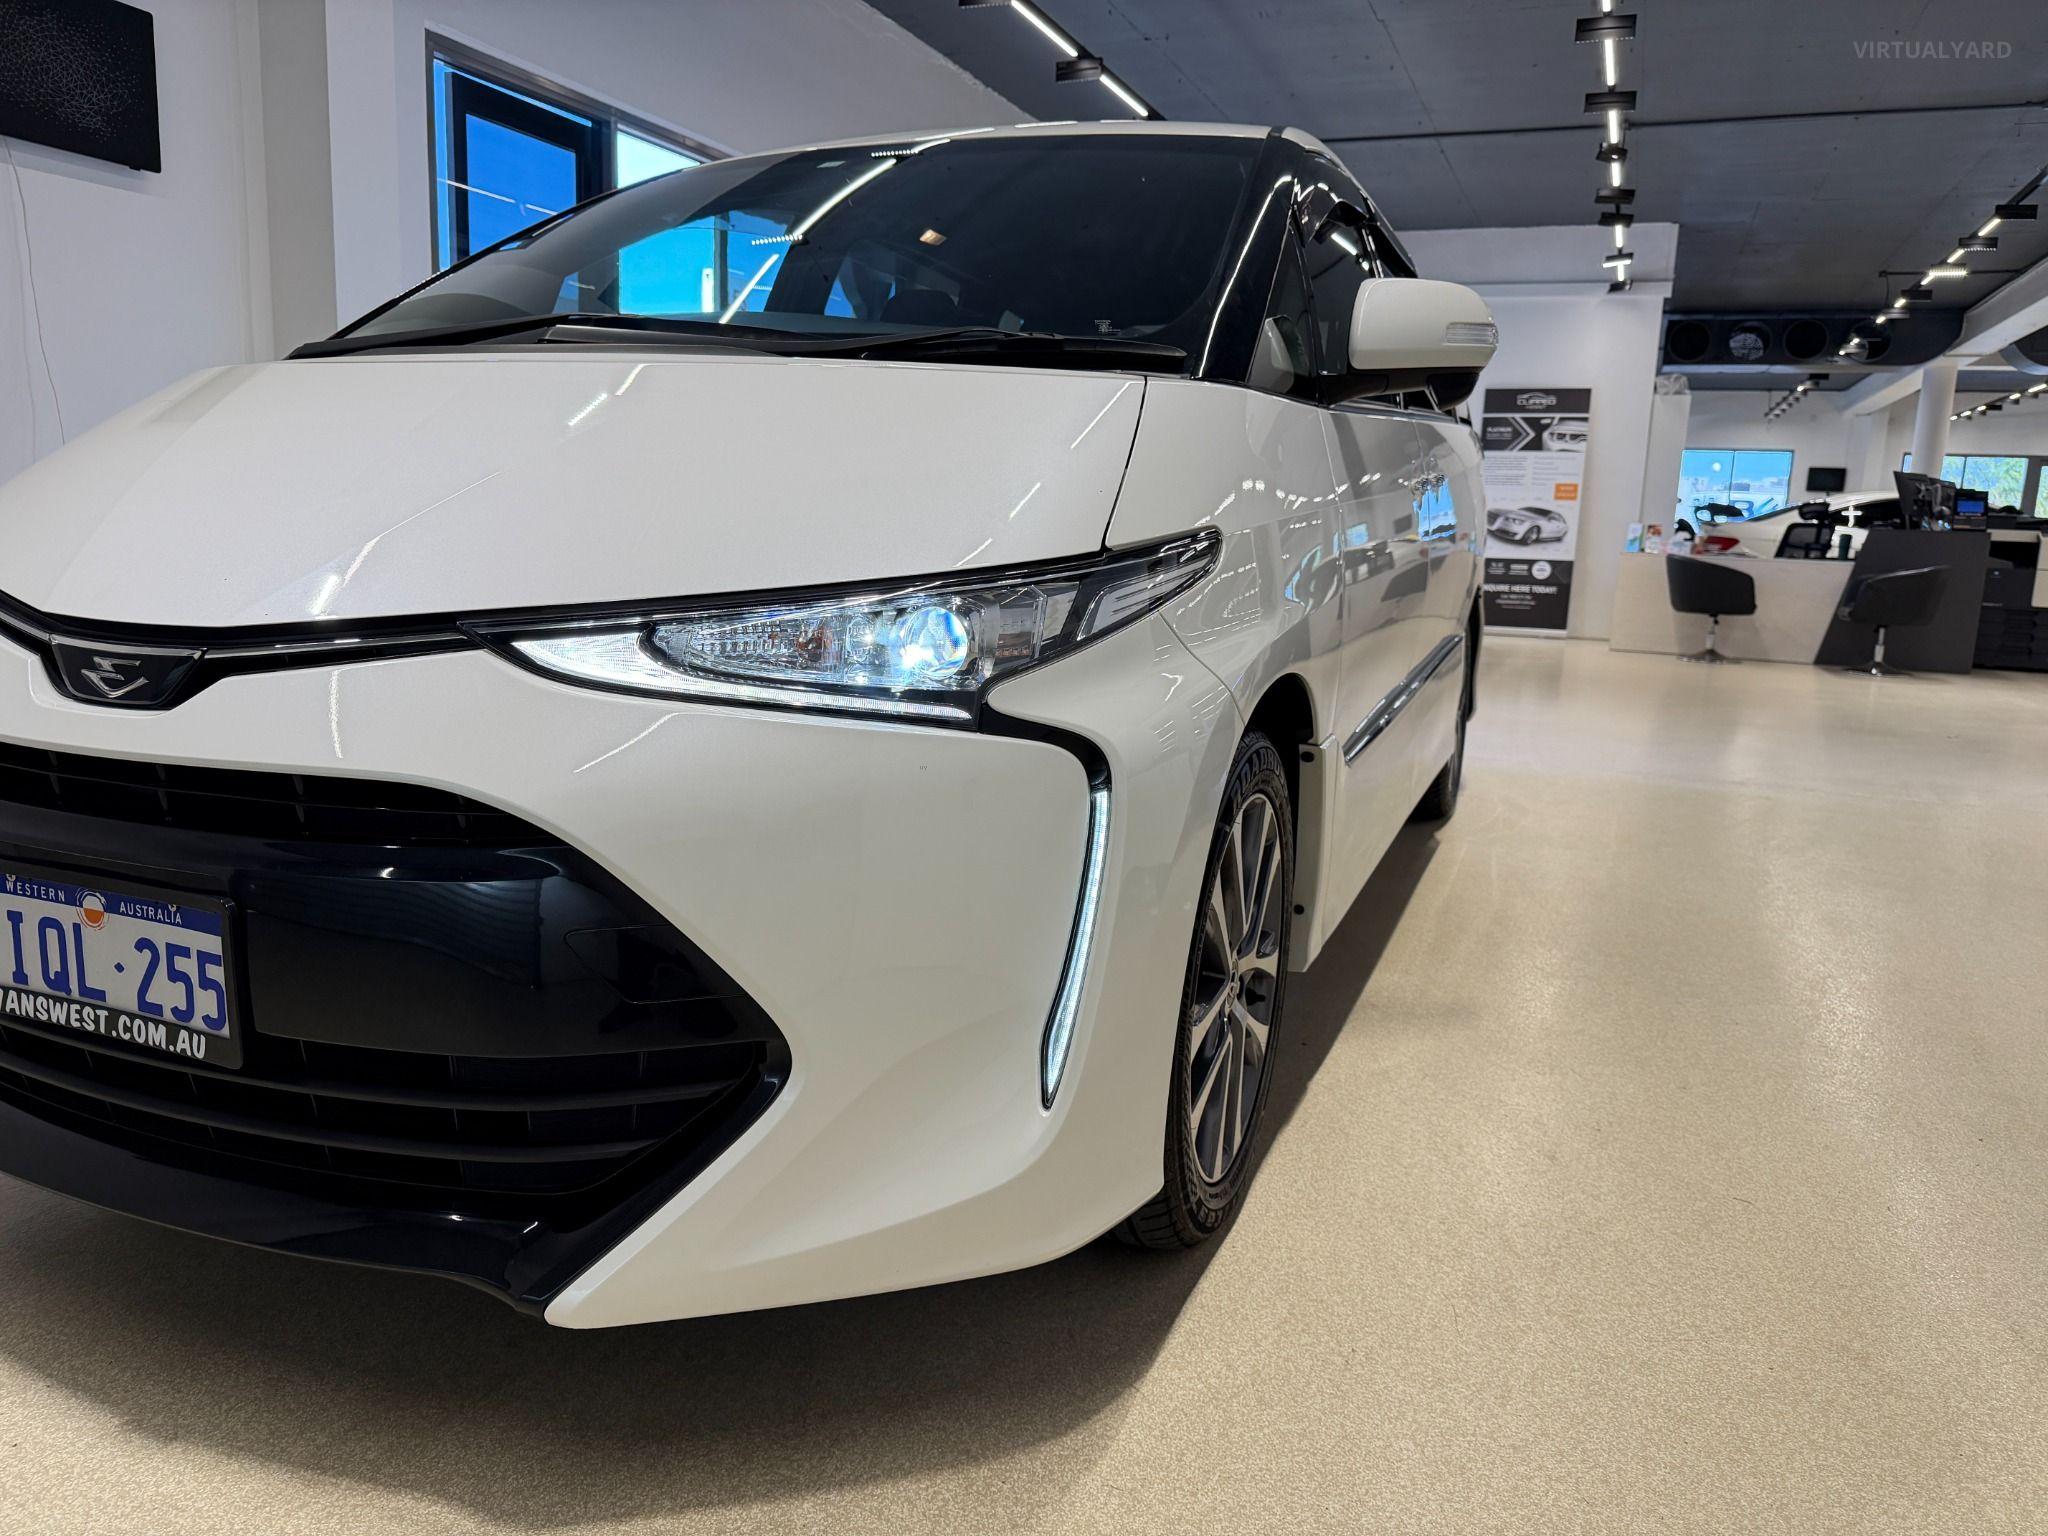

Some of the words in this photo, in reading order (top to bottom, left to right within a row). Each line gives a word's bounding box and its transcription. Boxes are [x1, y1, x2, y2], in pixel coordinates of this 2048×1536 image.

[1482, 583, 1510, 593] NQUIRE
[1511, 584, 1531, 594] HERE
[6, 879, 66, 902] WESTERN
[119, 901, 182, 925] AUSTRALIA
